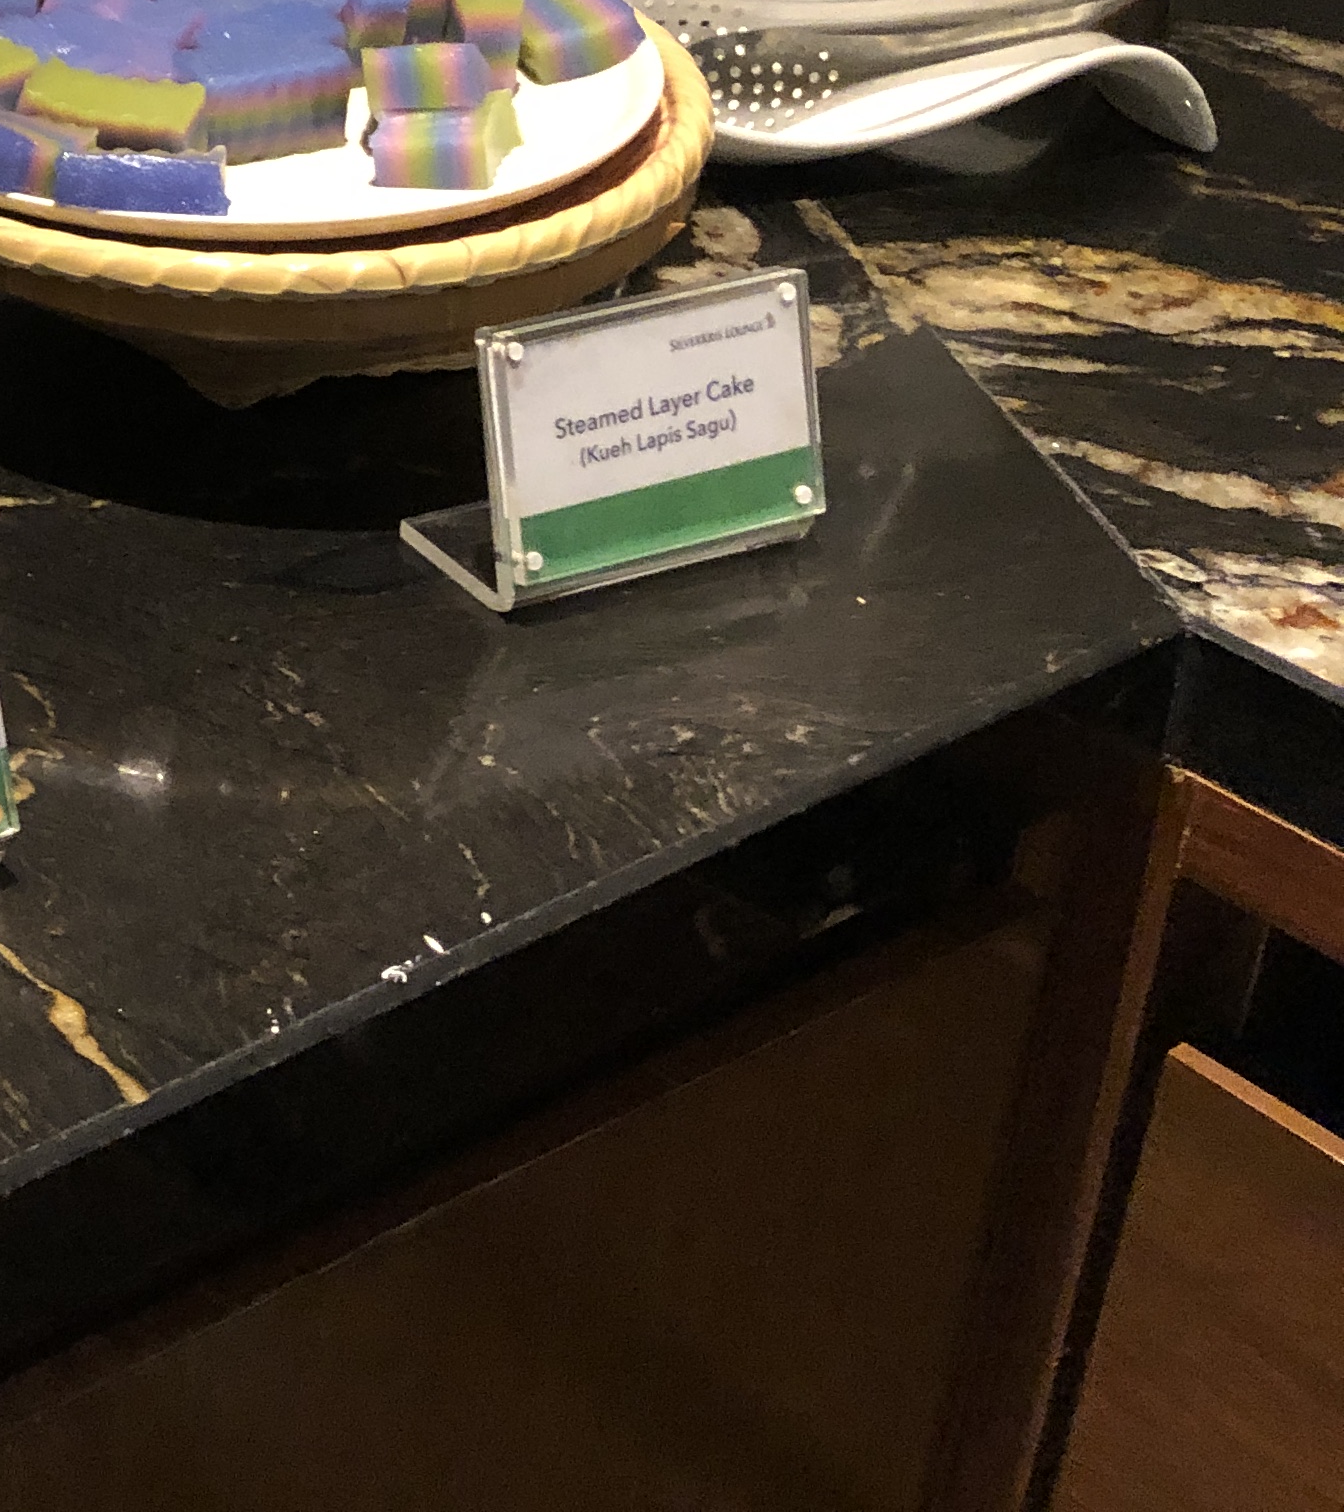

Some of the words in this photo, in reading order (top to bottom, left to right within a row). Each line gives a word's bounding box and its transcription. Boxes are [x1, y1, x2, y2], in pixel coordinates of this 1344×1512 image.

[555, 399, 643, 440] Steamed
[647, 389, 702, 420] Layer
[705, 375, 755, 401] Cake
[579, 436, 632, 468] (Kueh
[636, 425, 682, 453] Lapis
[686, 409, 738, 440] Sagu)
